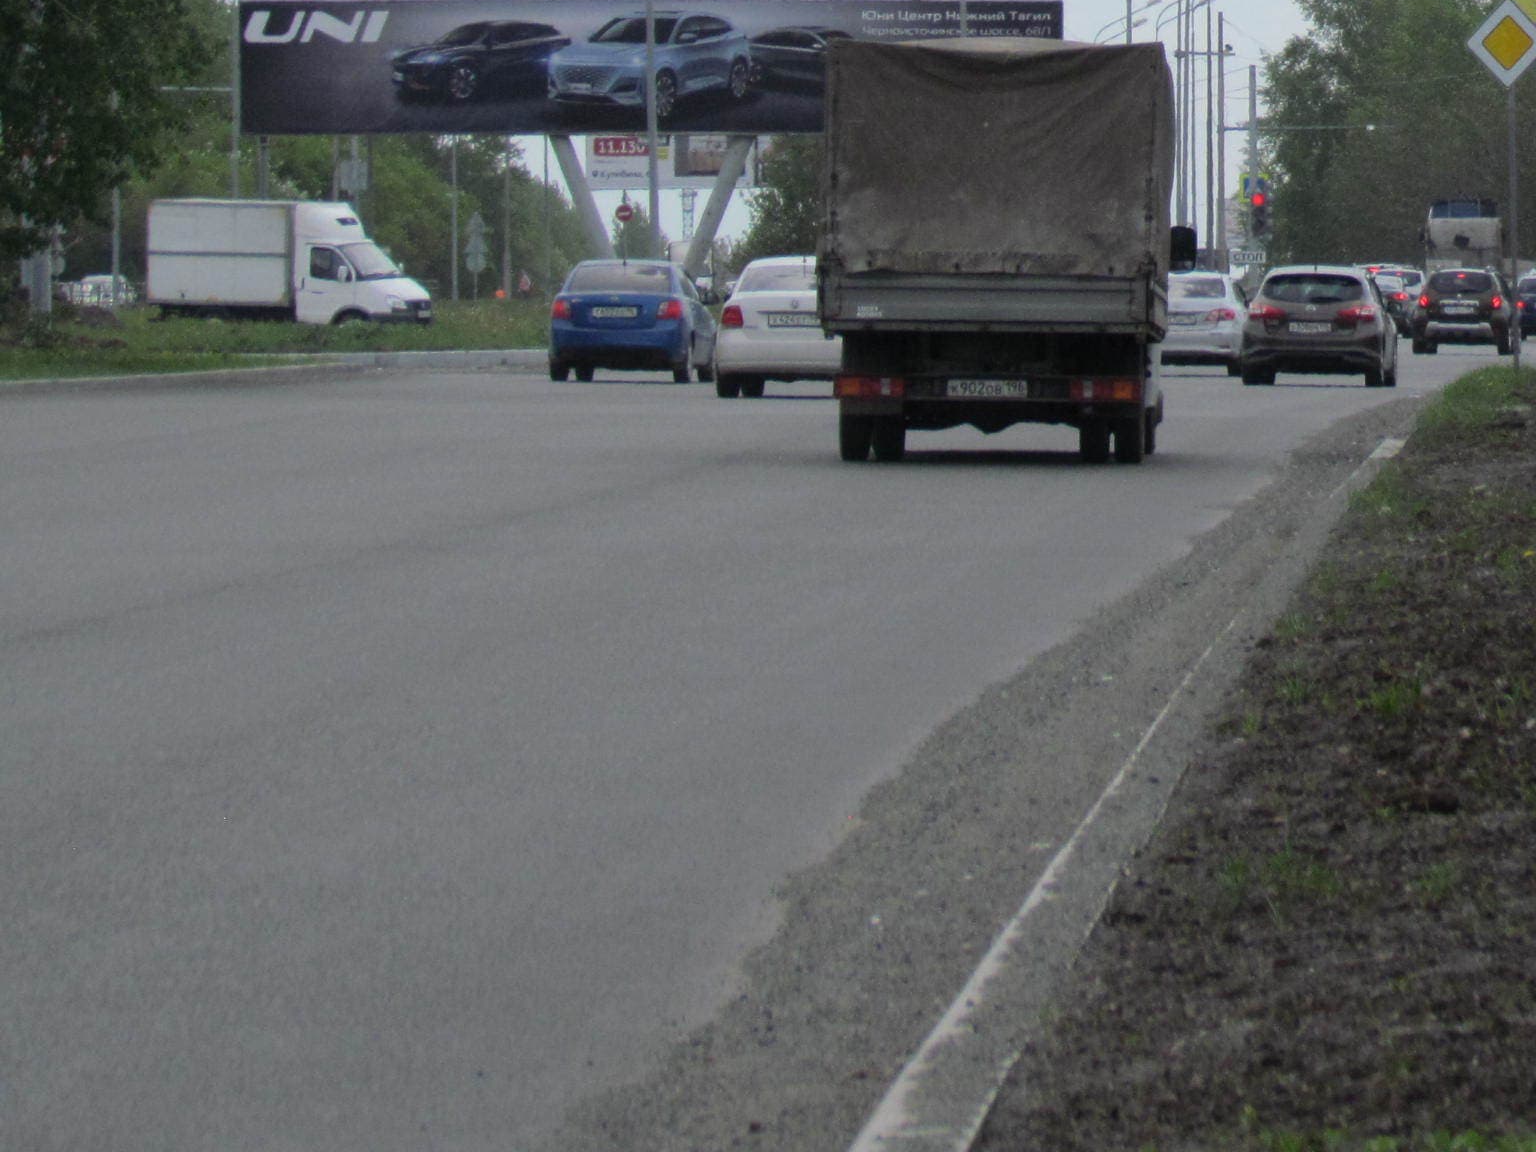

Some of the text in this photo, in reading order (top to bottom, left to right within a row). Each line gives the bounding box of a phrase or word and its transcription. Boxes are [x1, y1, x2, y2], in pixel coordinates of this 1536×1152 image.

[243, 10, 389, 43] UNI
[862, 10, 894, 20] Юни
[898, 10, 942, 22] Центр
[1009, 10, 1050, 20] Тагил
